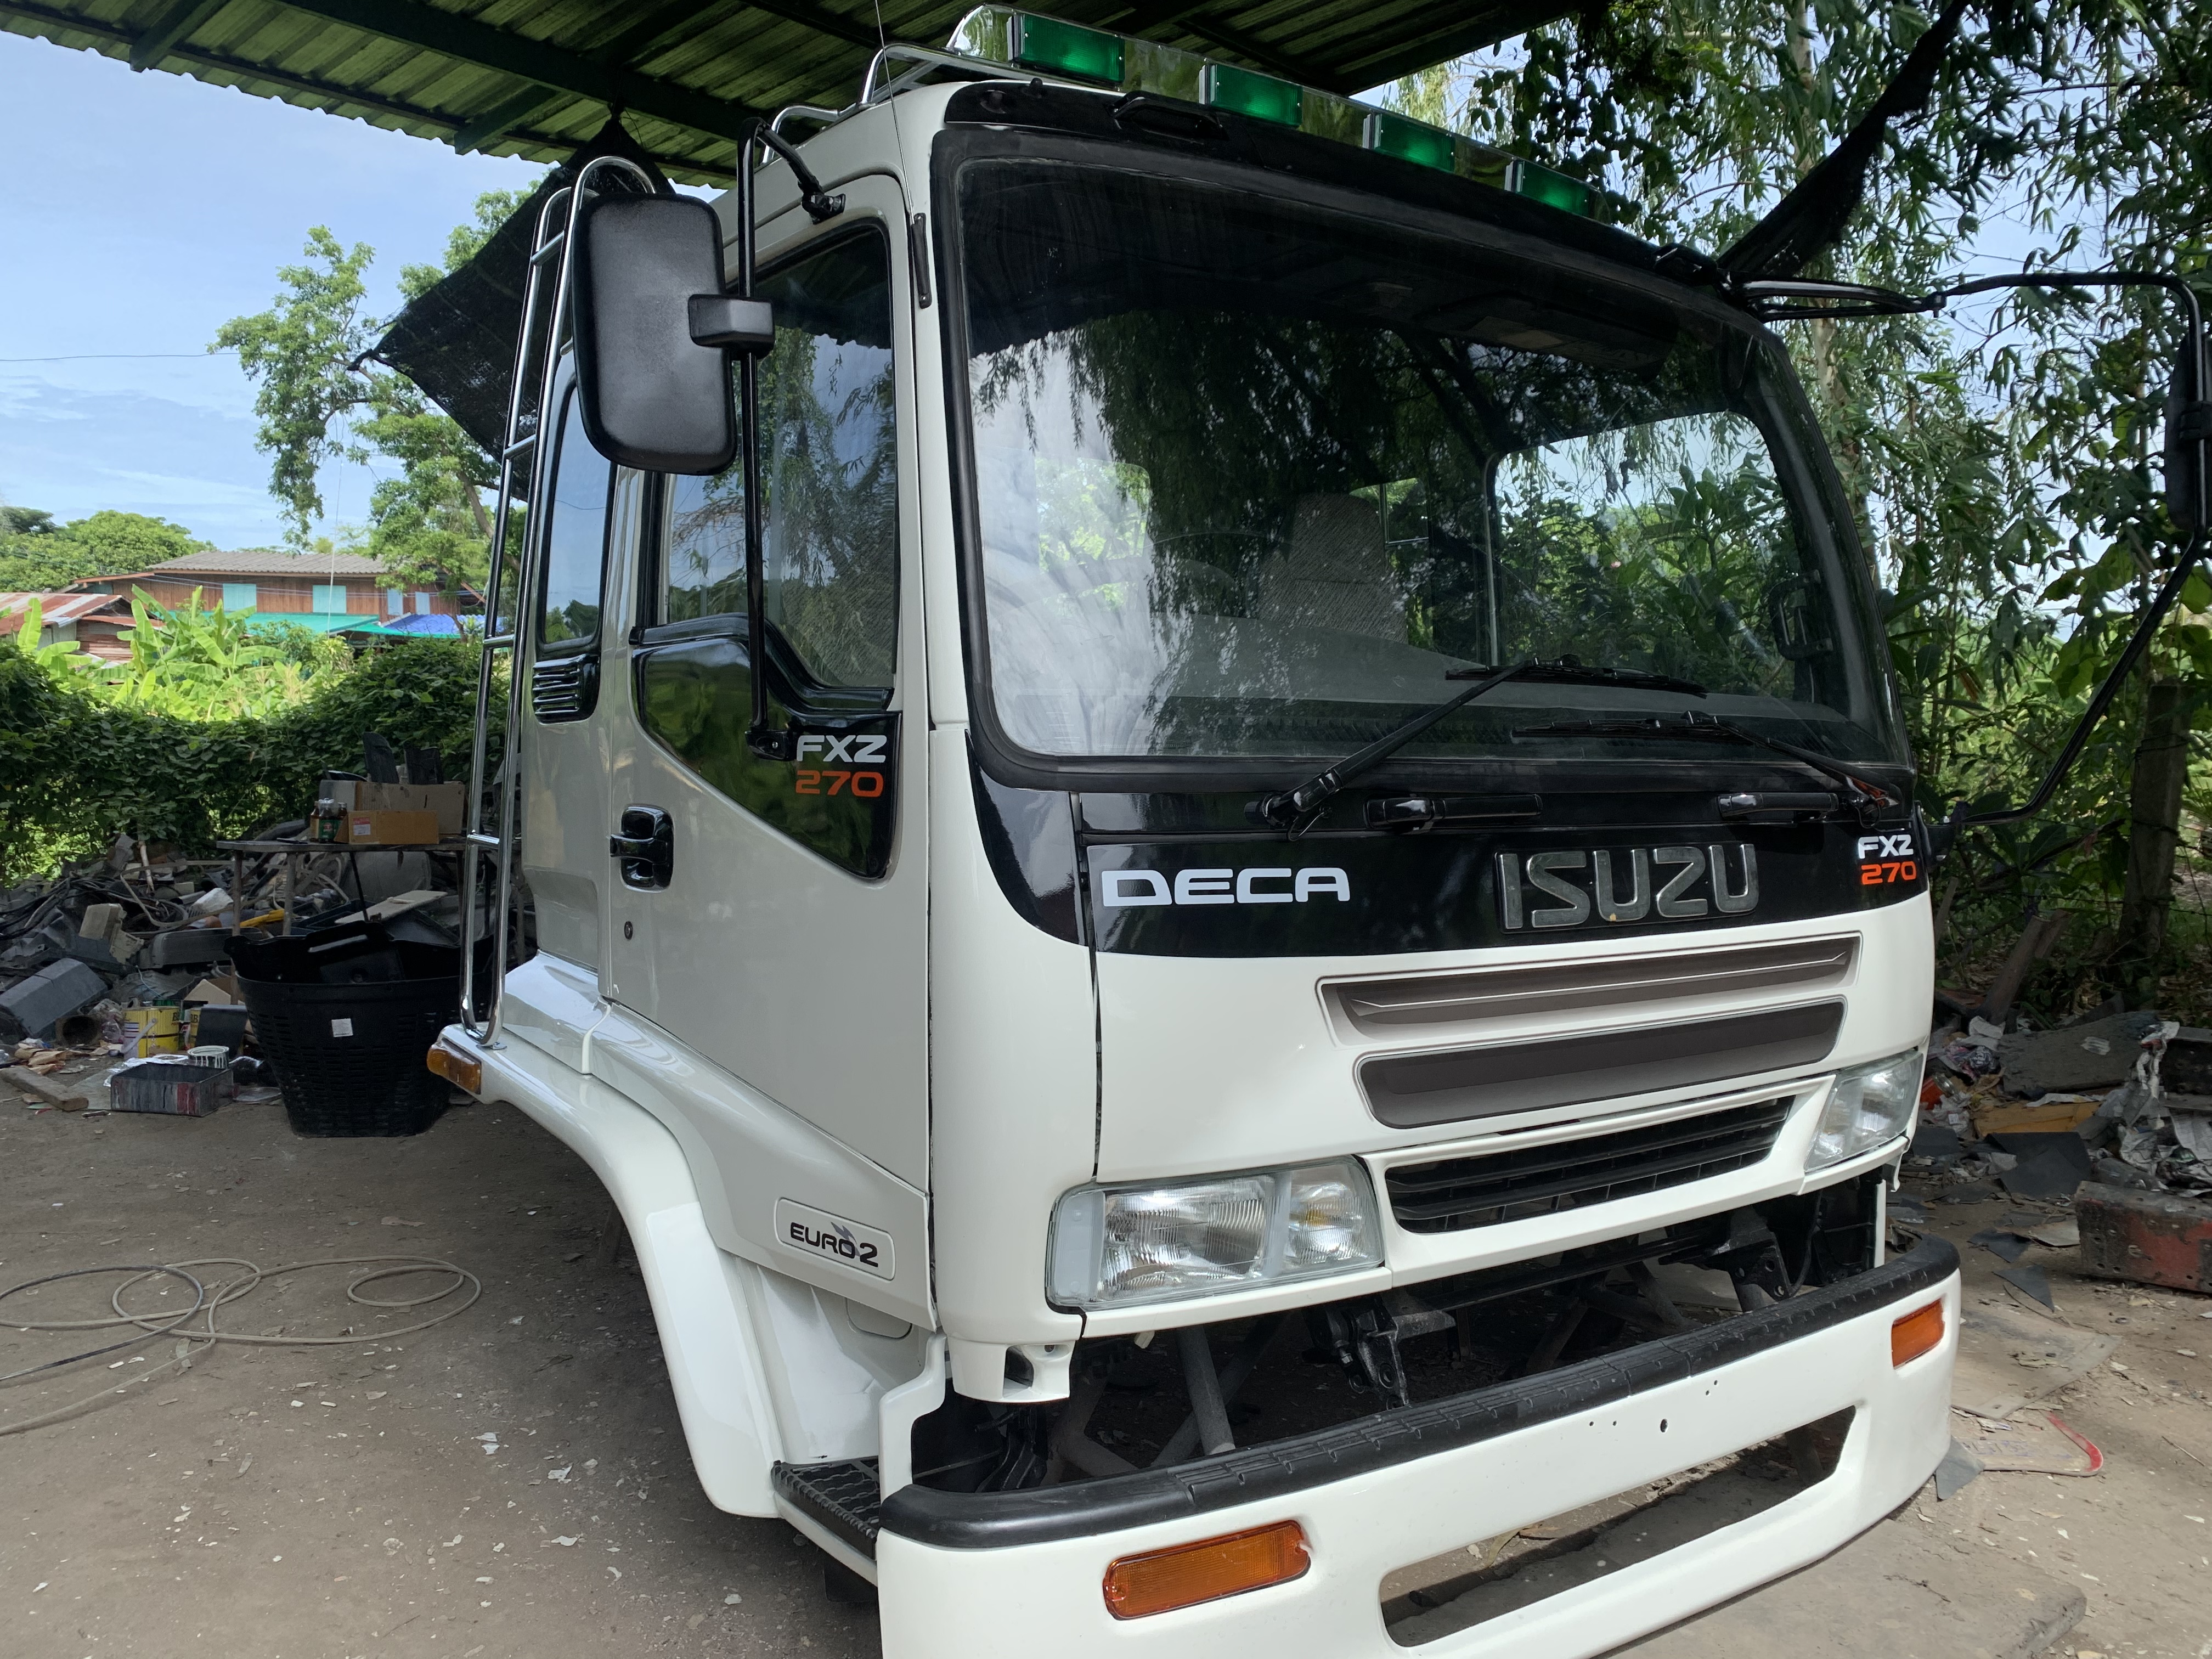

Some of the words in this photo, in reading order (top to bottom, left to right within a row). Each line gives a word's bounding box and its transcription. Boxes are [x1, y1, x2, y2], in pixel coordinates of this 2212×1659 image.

[796, 735, 887, 763] FXZ
[795, 770, 884, 798] 270
[1858, 834, 1914, 859] FXZ
[1101, 867, 1351, 907] DECA
[1499, 843, 1760, 929] ISUZU
[1861, 861, 1917, 885] 270
